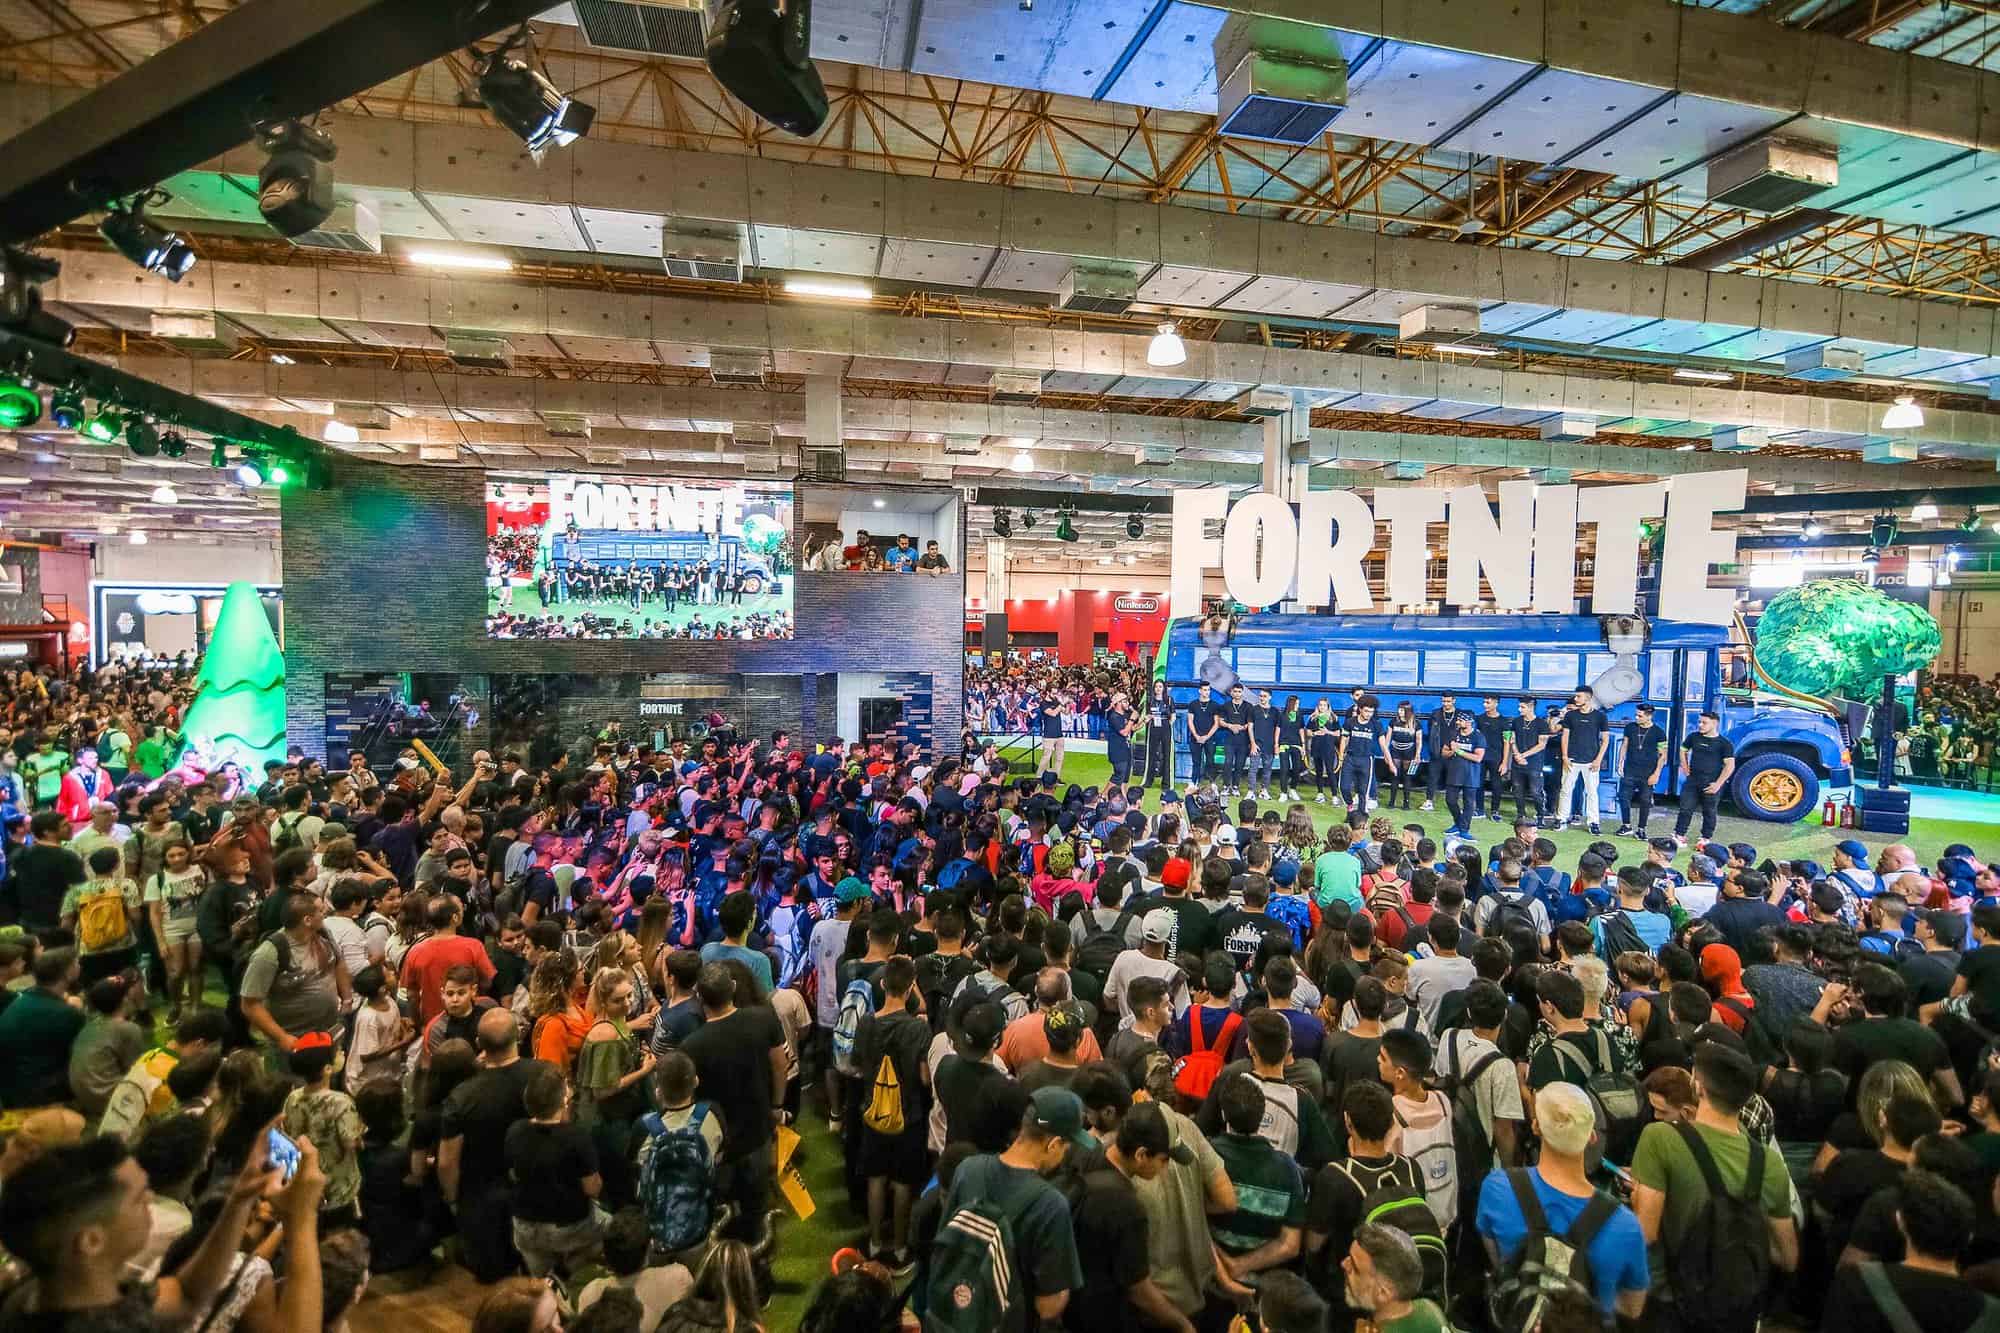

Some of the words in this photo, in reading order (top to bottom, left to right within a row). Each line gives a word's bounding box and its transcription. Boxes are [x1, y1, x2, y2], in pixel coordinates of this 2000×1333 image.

[1170, 468, 1748, 625] FORTNITE
[1875, 576, 1905, 585] AOC
[1117, 599, 1153, 610] Nintendo
[640, 703, 683, 716] FORTNITE
